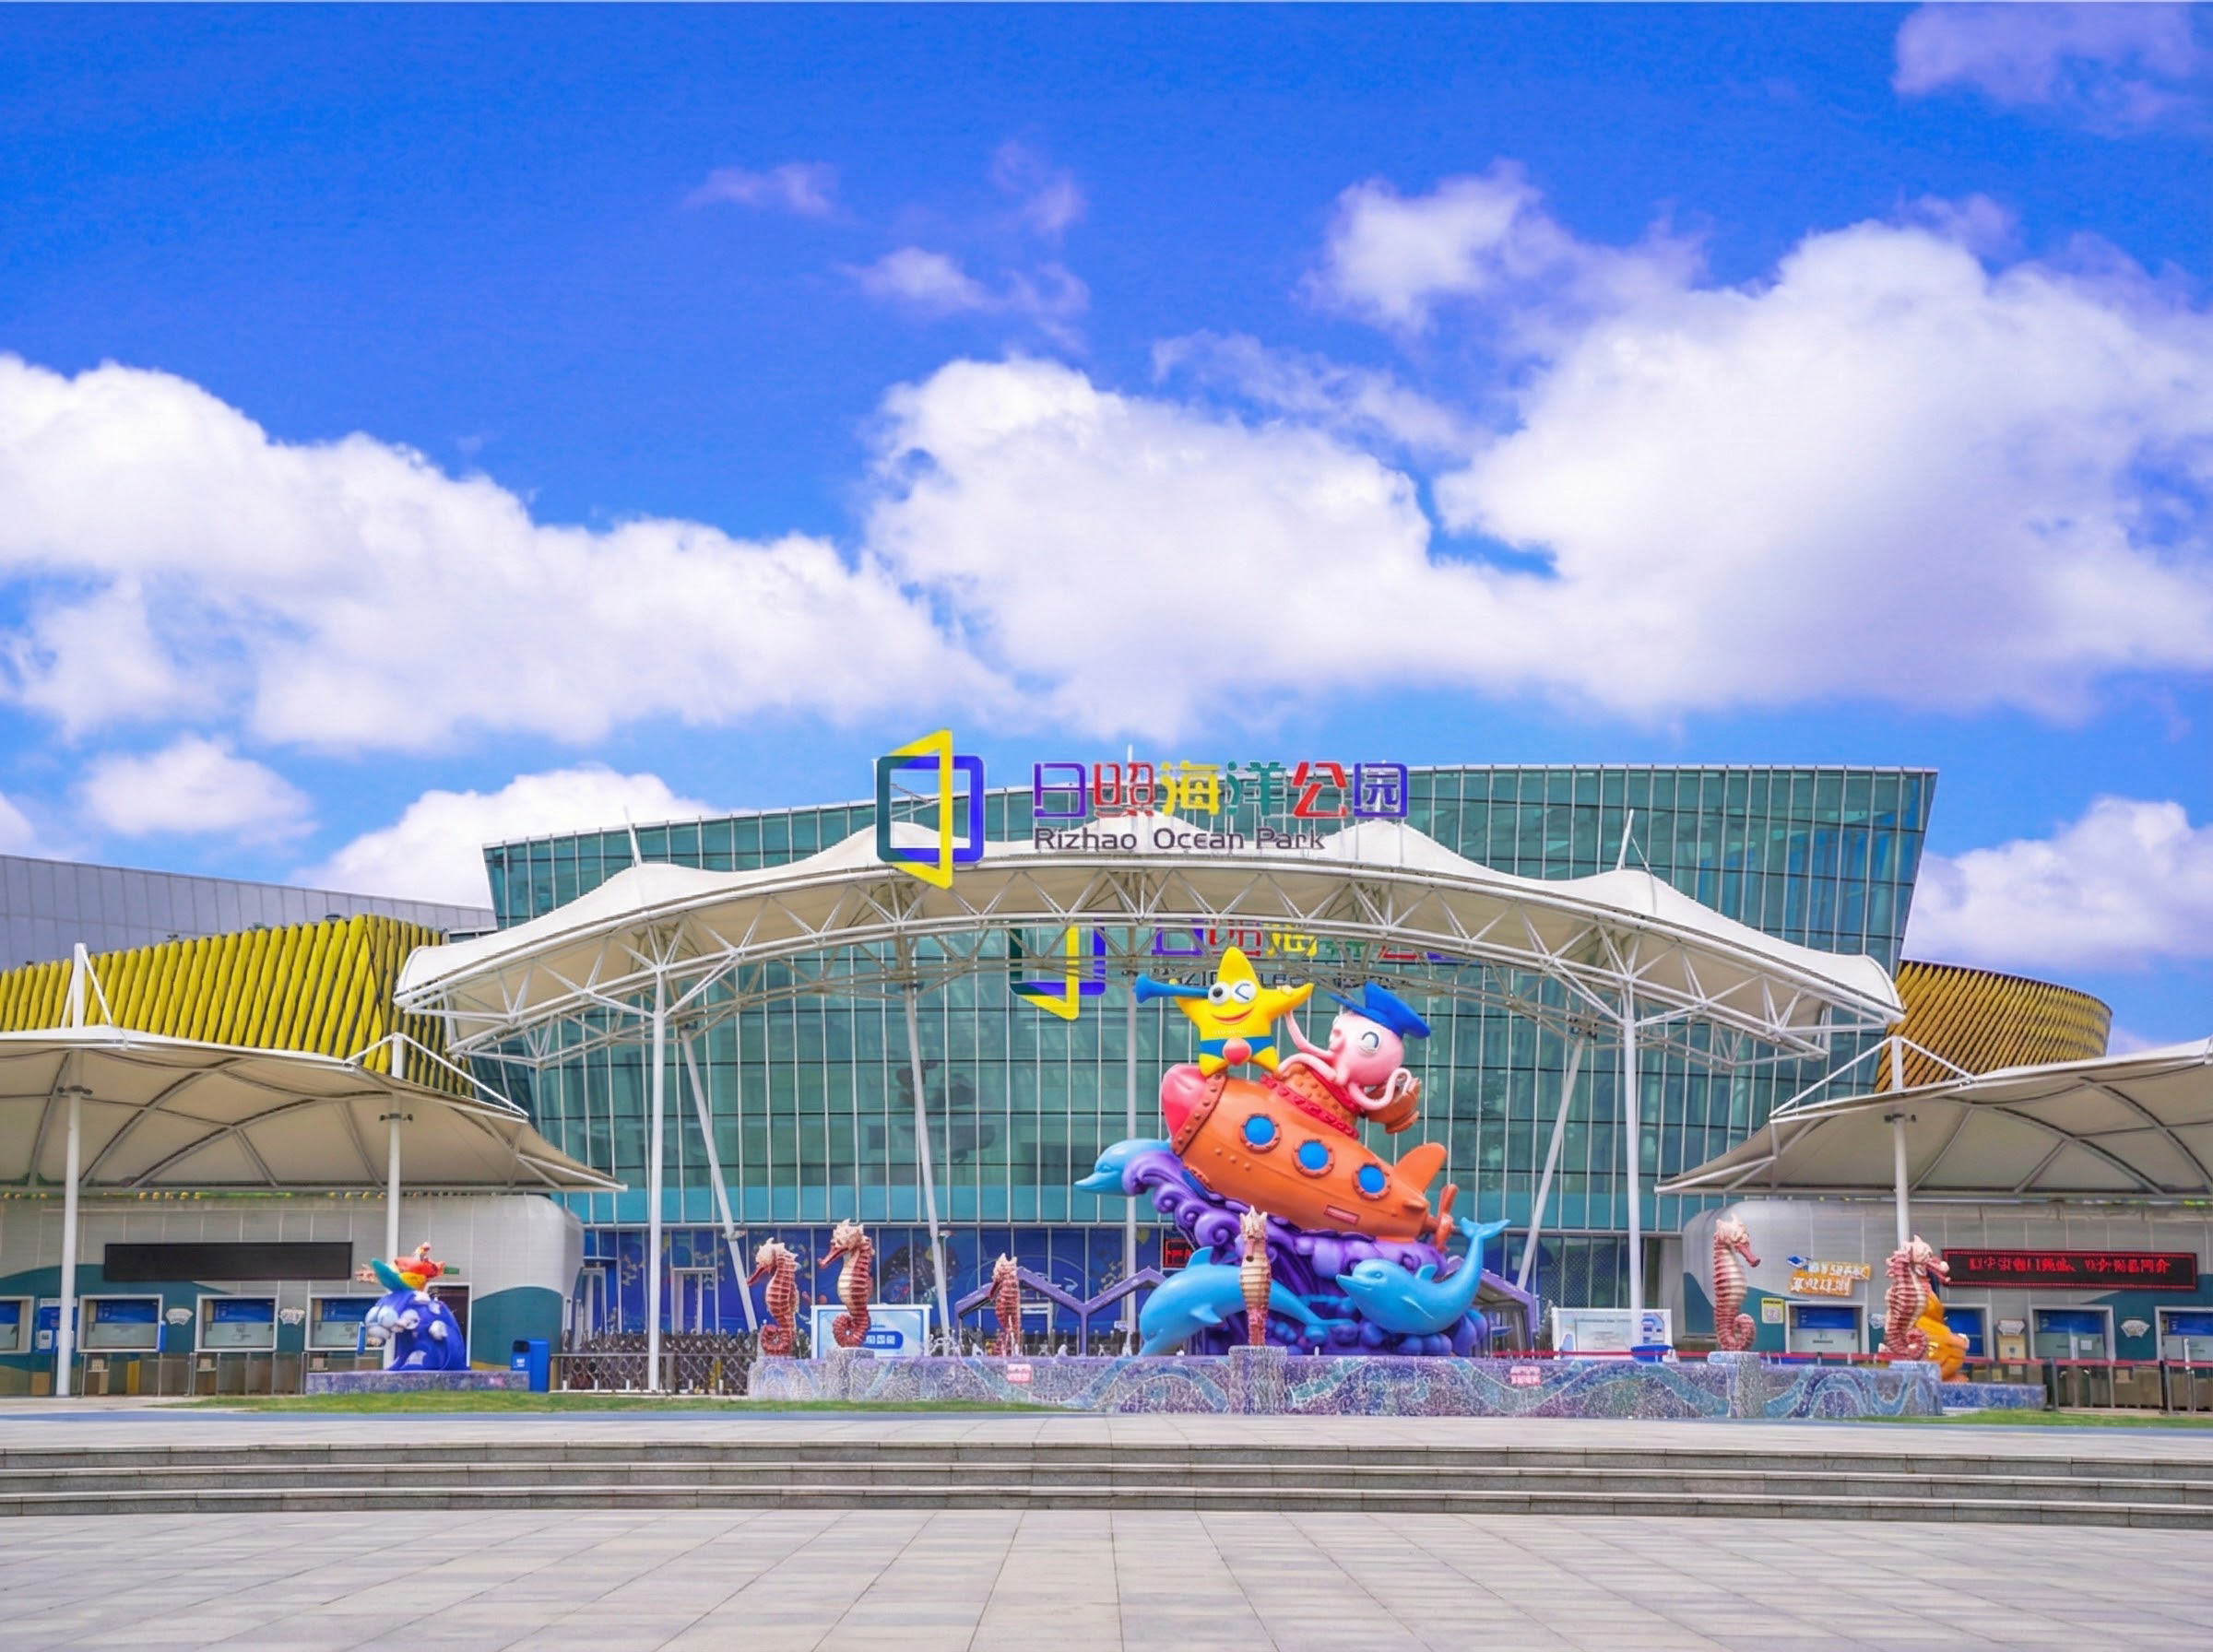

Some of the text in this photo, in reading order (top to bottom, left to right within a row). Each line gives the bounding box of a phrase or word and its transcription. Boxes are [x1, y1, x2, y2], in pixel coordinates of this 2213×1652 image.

[1033, 761, 1408, 819] 日照海洋公园
[1035, 828, 1325, 851] Rizhao Ocean Park
